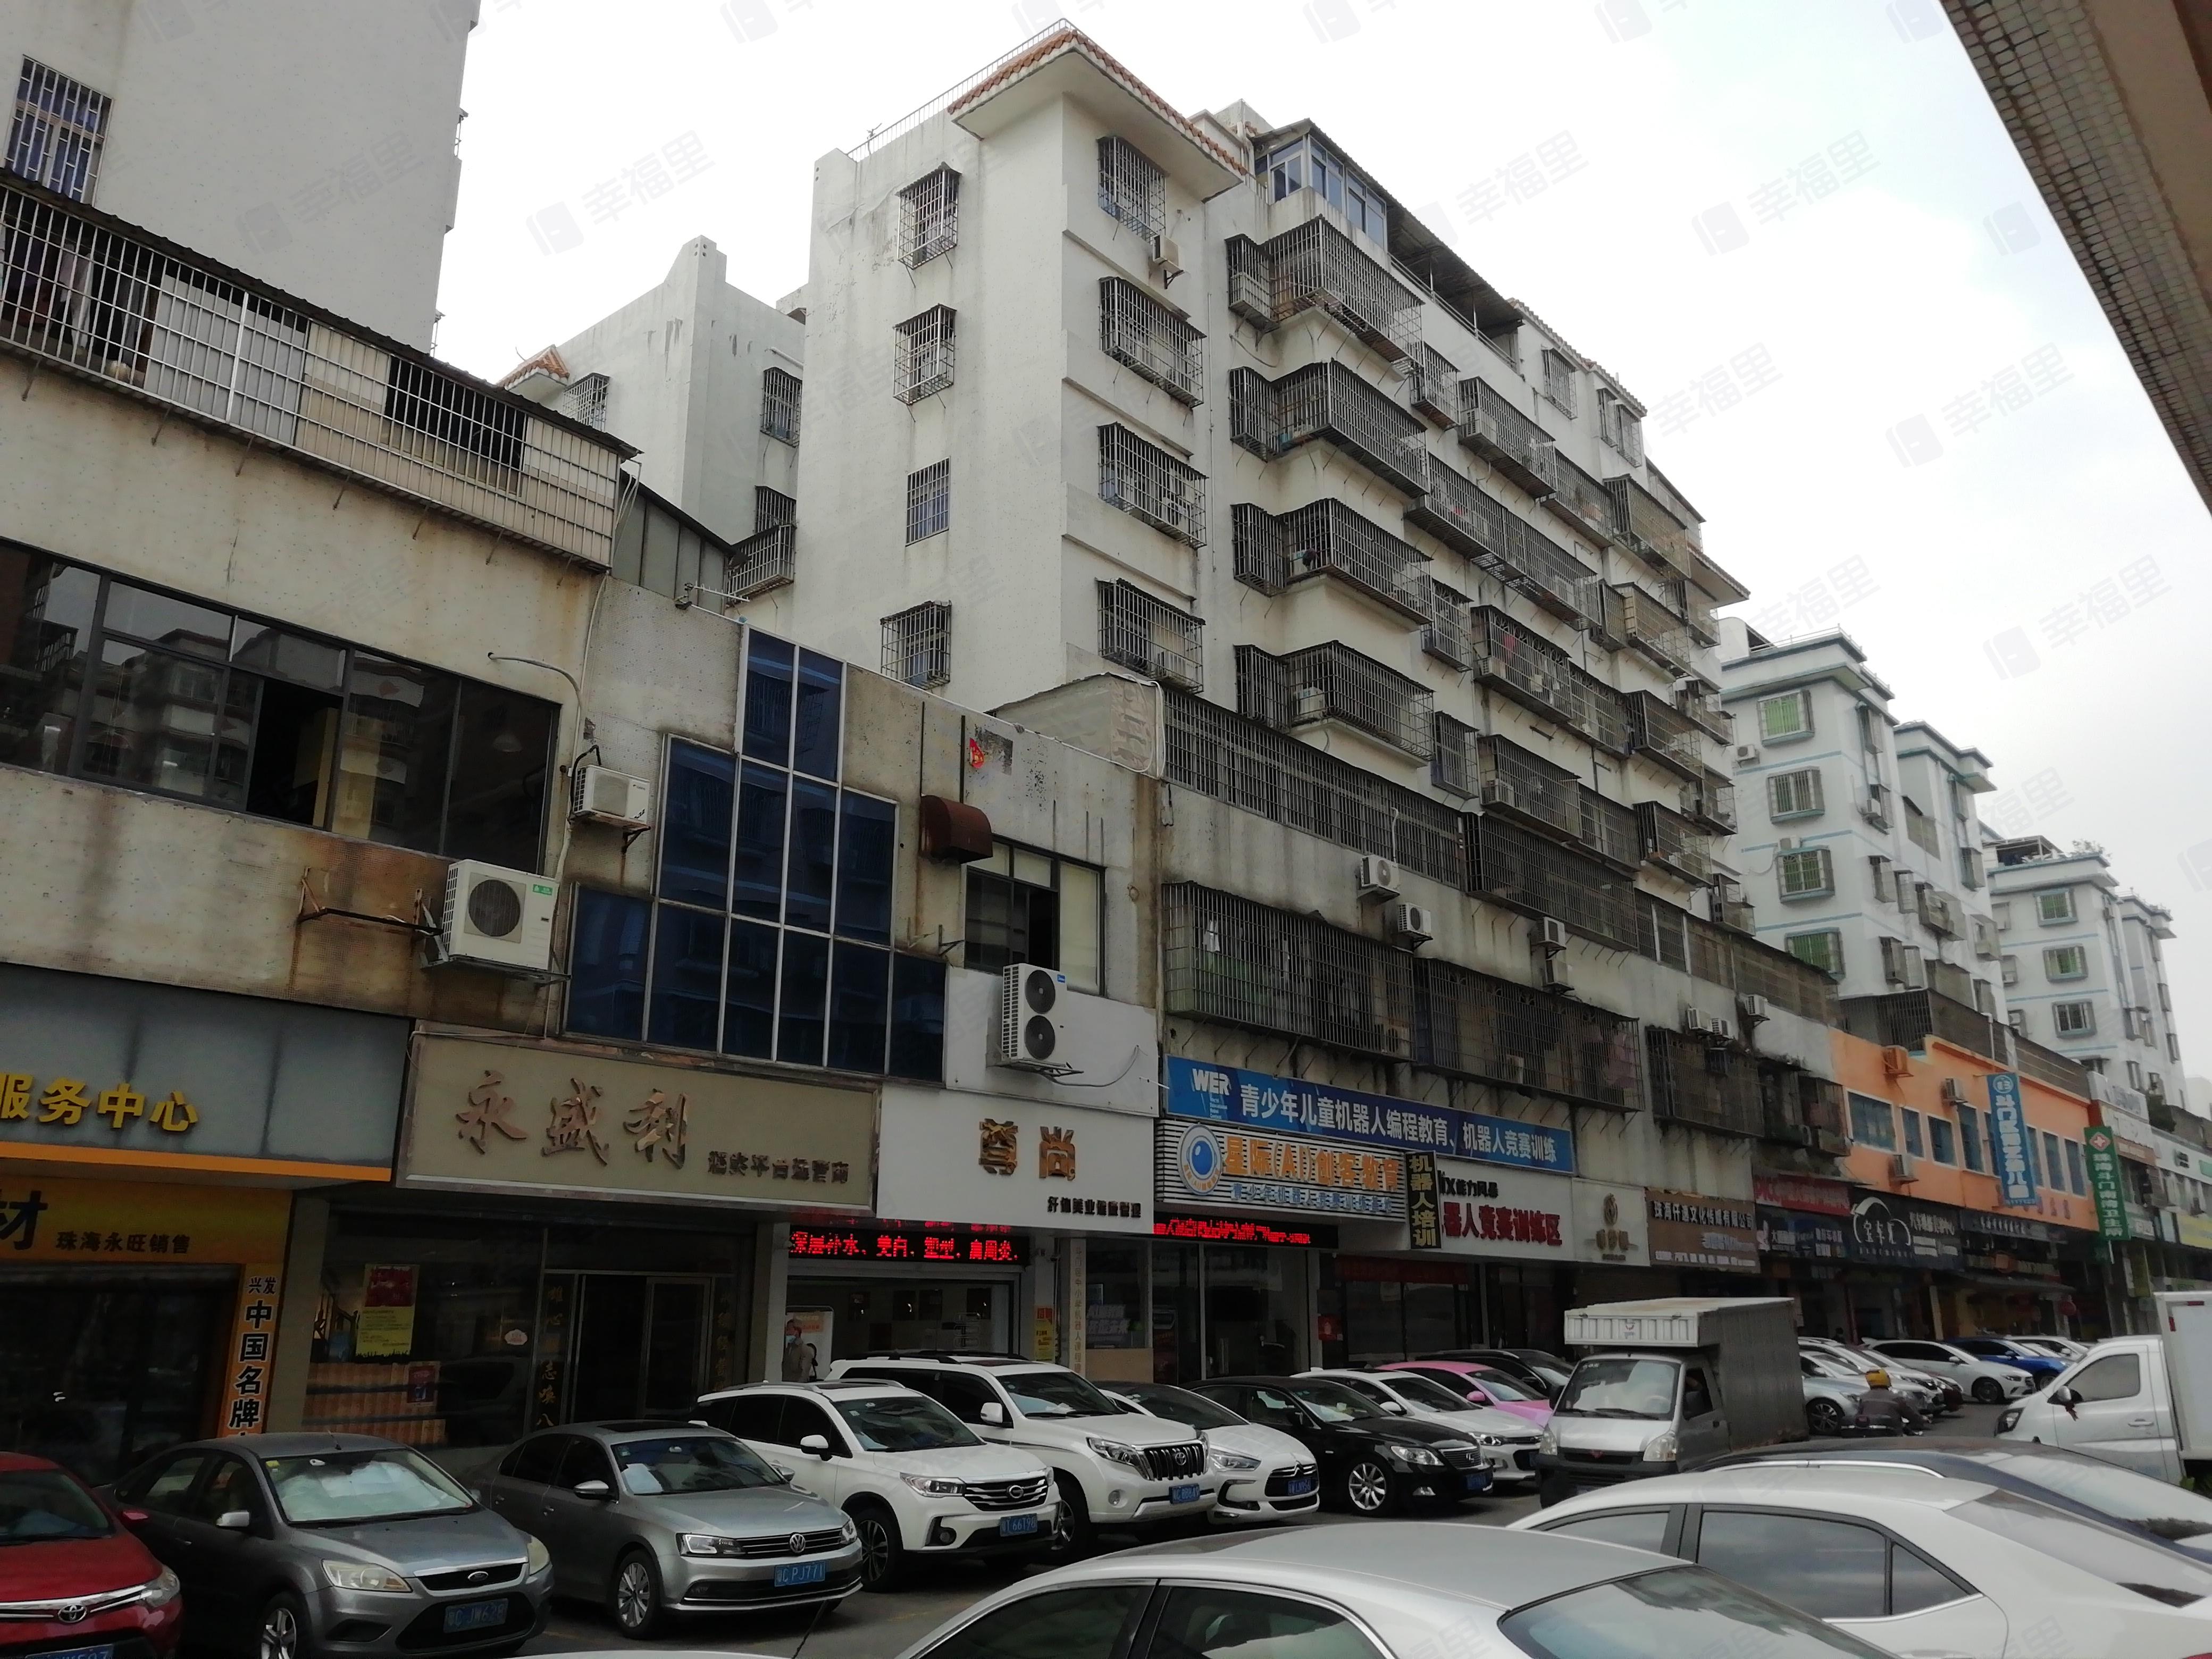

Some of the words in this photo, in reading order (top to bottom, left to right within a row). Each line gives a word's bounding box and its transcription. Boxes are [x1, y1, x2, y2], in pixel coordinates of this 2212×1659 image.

[0, 1073, 199, 1133] 服务中心
[1192, 1068, 1231, 1096] WER
[1240, 1083, 1557, 1163] 青少年儿童机器人编程教育、机器人竞赛训练
[1409, 1154, 1437, 1247] 机器人培训
[1442, 1202, 1562, 1246] 器人竞赛训练区
[55, 1231, 190, 1254] 珠海永旺销售
[248, 1277, 276, 1295] 兴发
[229, 1300, 273, 1437] 中国名牌
